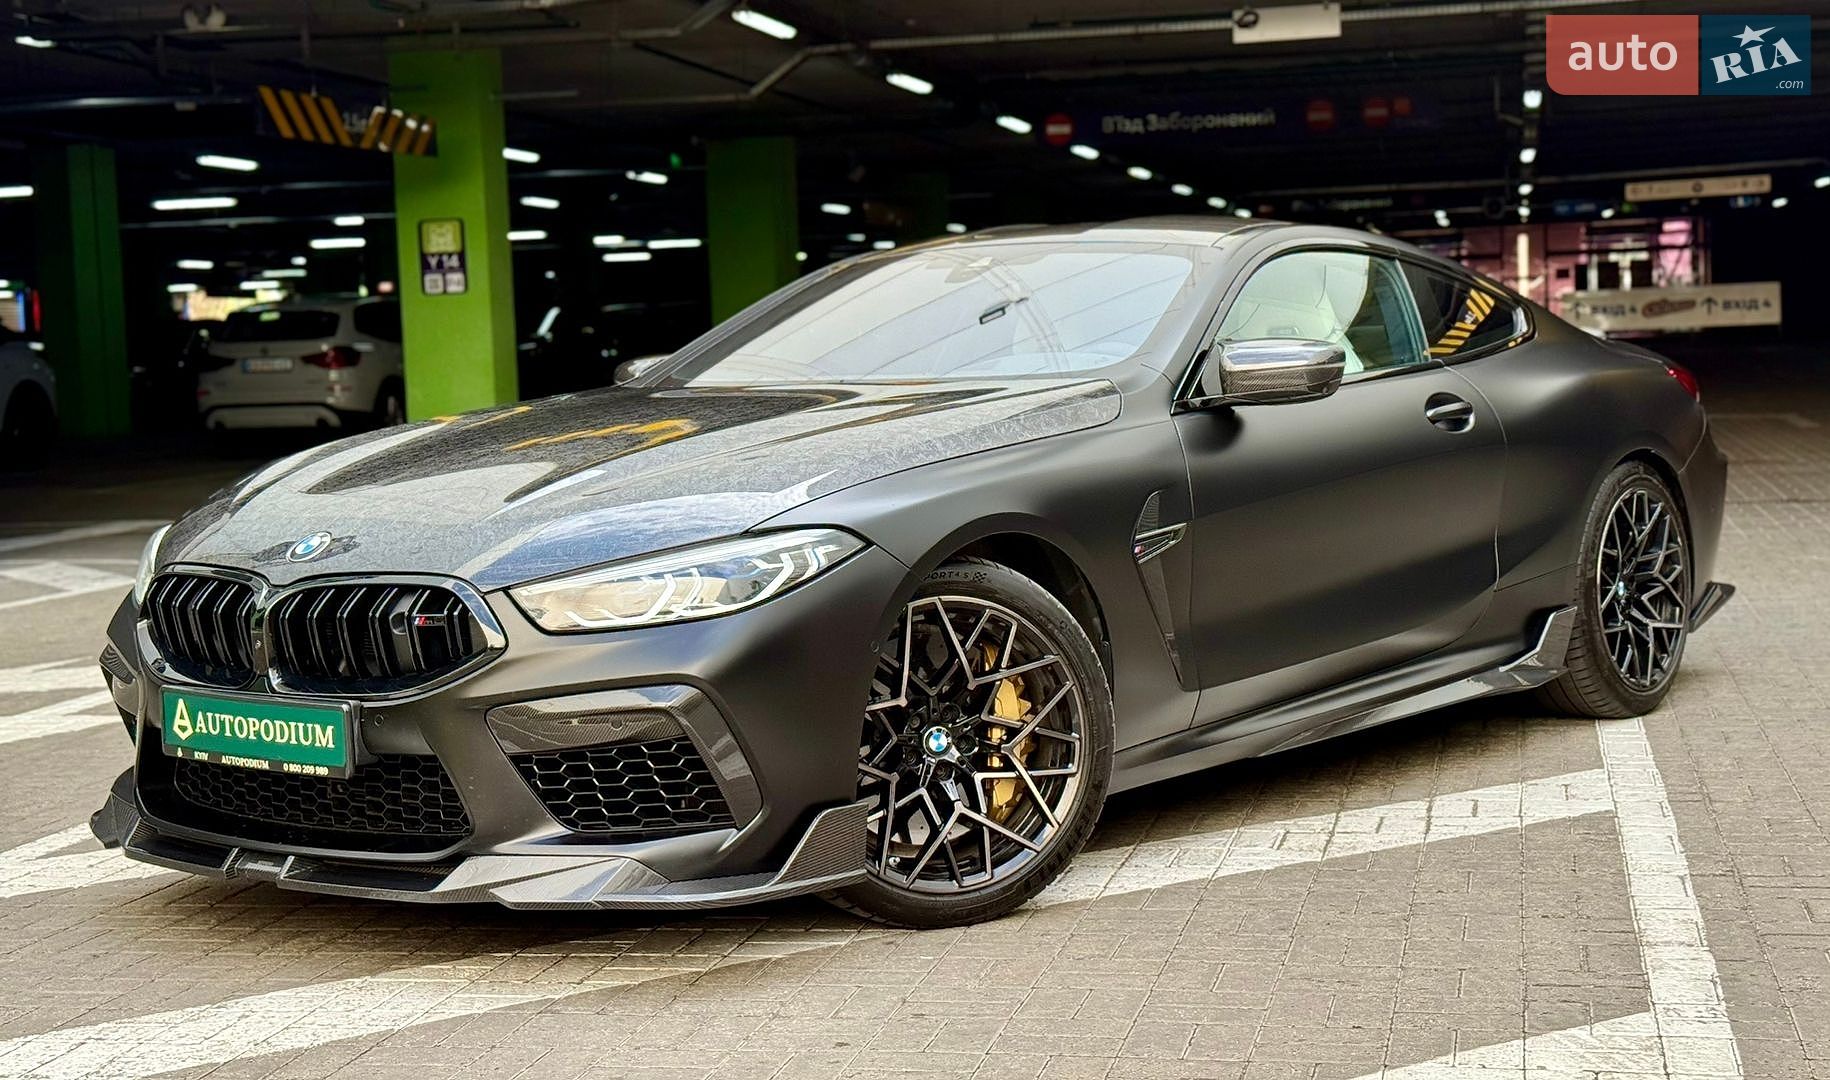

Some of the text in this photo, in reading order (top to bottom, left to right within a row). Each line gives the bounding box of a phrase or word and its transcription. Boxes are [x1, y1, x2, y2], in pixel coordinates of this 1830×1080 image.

[922, 571, 954, 581] PORT
[195, 711, 336, 749] AUTOPODIUM
[221, 755, 270, 770] AUTOPODIUM
